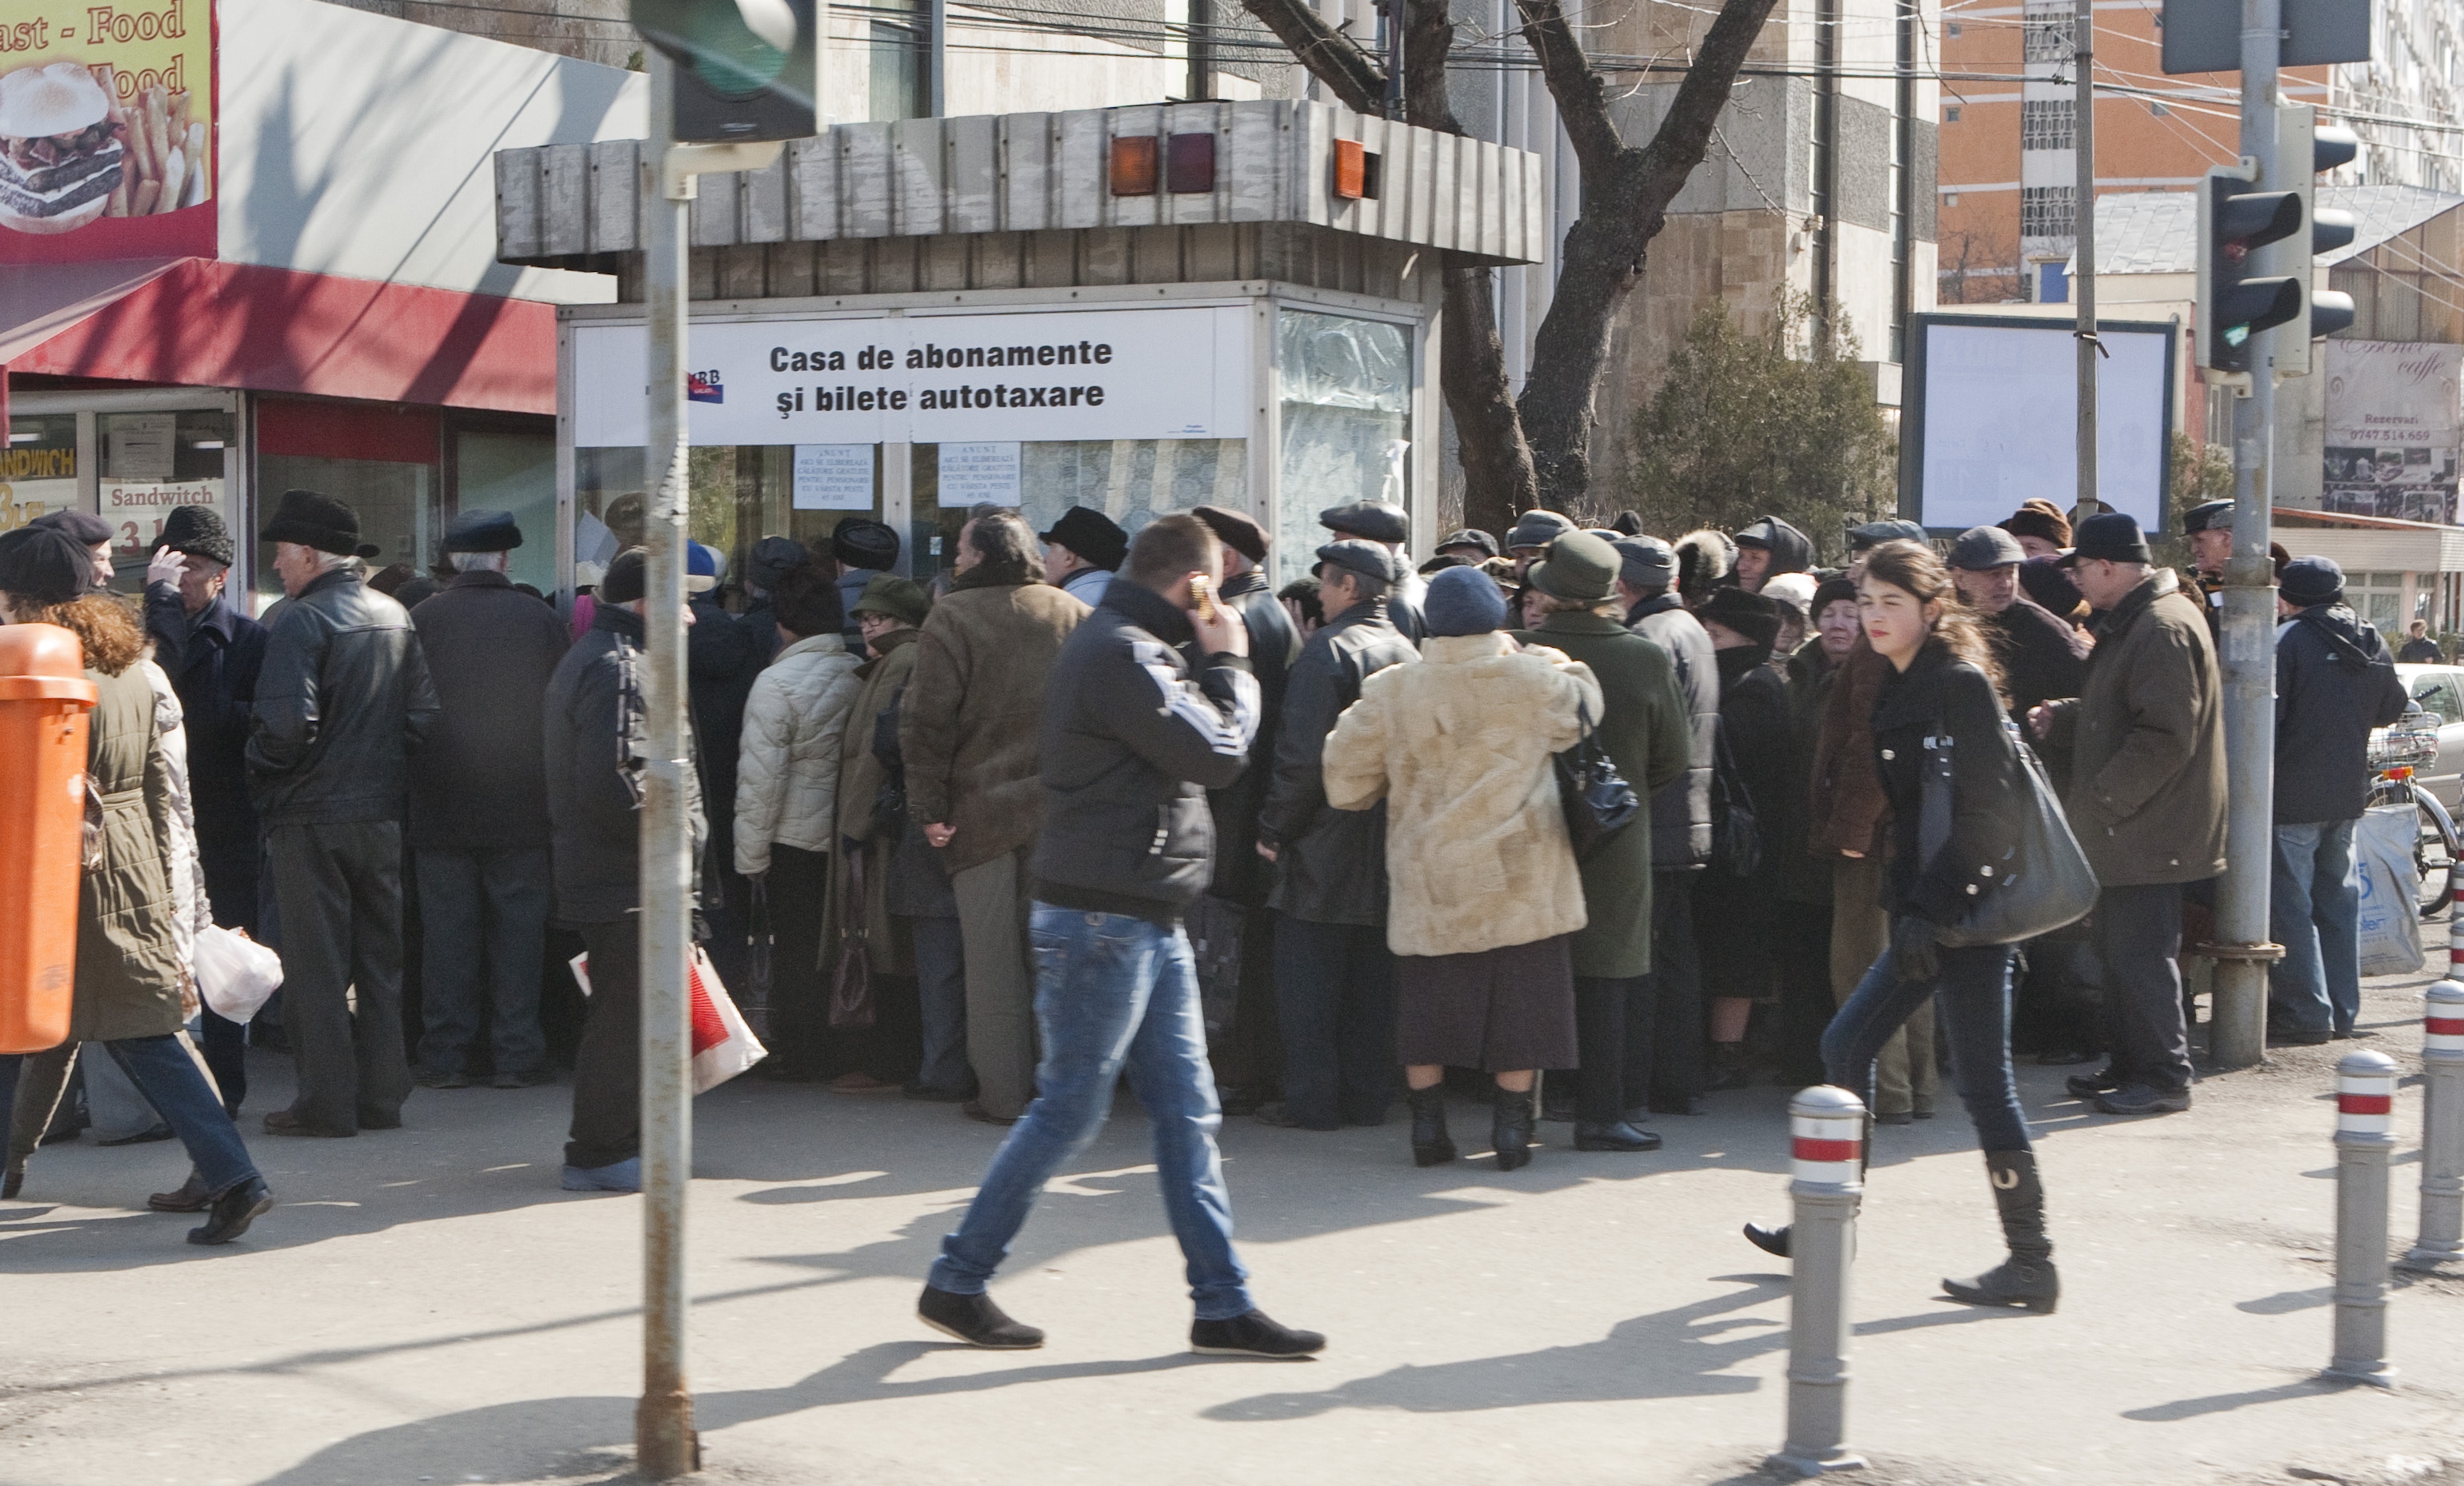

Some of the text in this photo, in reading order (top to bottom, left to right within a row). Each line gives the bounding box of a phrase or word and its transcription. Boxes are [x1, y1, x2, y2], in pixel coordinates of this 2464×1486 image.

[86, 0, 186, 45] Food
[771, 342, 1111, 372] Casa de abonamente
[817, 386, 906, 411] bilete
[921, 385, 1103, 409] autotaxare
[111, 485, 214, 506] Sandwitch
[121, 521, 141, 554] 3
